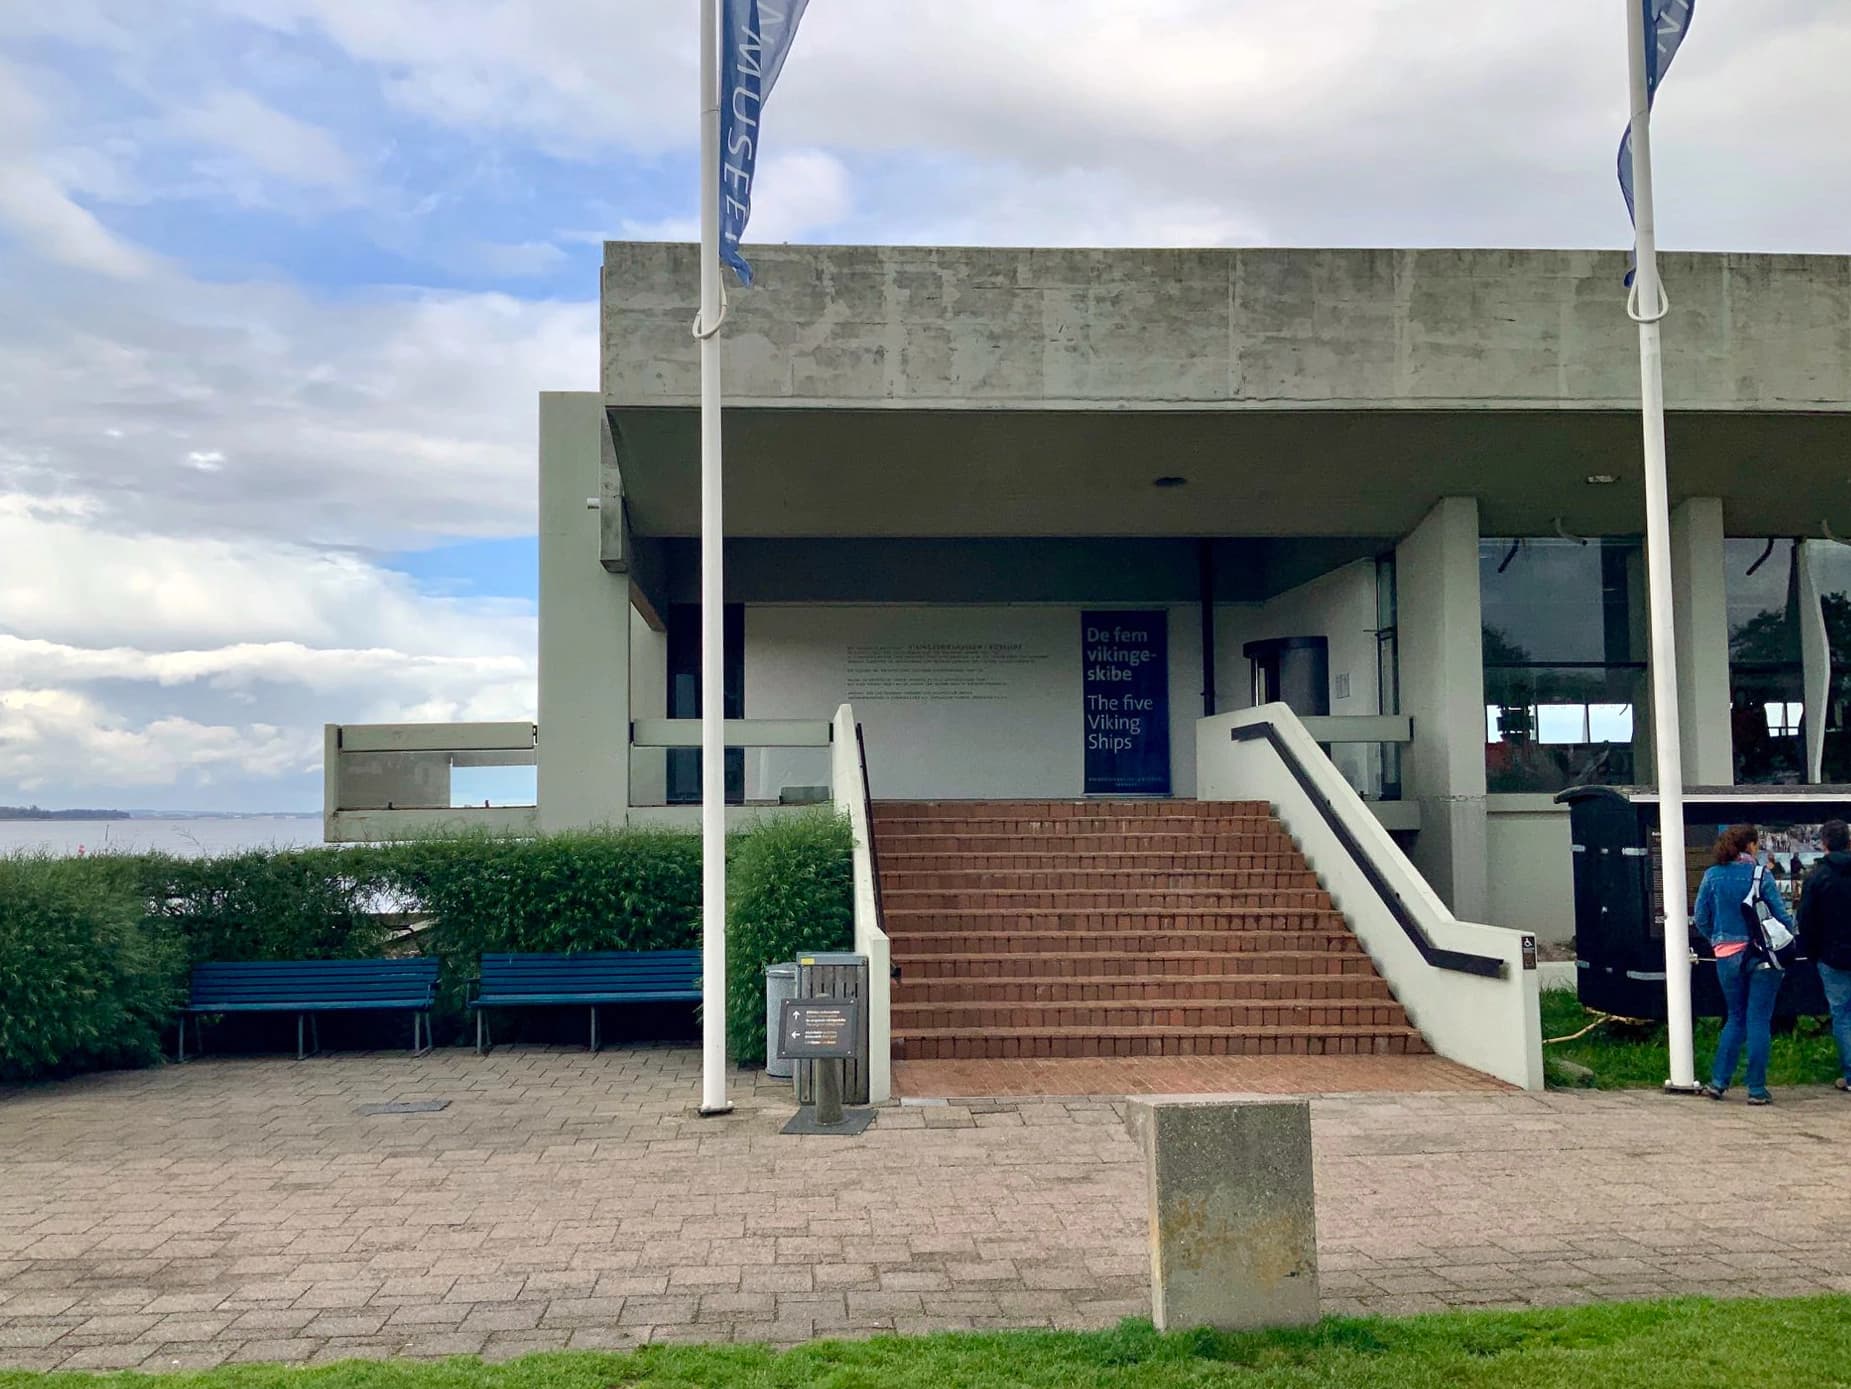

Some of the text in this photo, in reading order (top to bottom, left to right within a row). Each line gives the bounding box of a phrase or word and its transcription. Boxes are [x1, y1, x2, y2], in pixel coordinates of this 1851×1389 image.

[1087, 626, 1148, 642] De fem
[1087, 646, 1157, 667] vikinge-
[1087, 665, 1132, 681] skibe
[1087, 694, 1153, 711] The five
[1087, 714, 1141, 735] Viking
[1088, 733, 1132, 755] Ships
